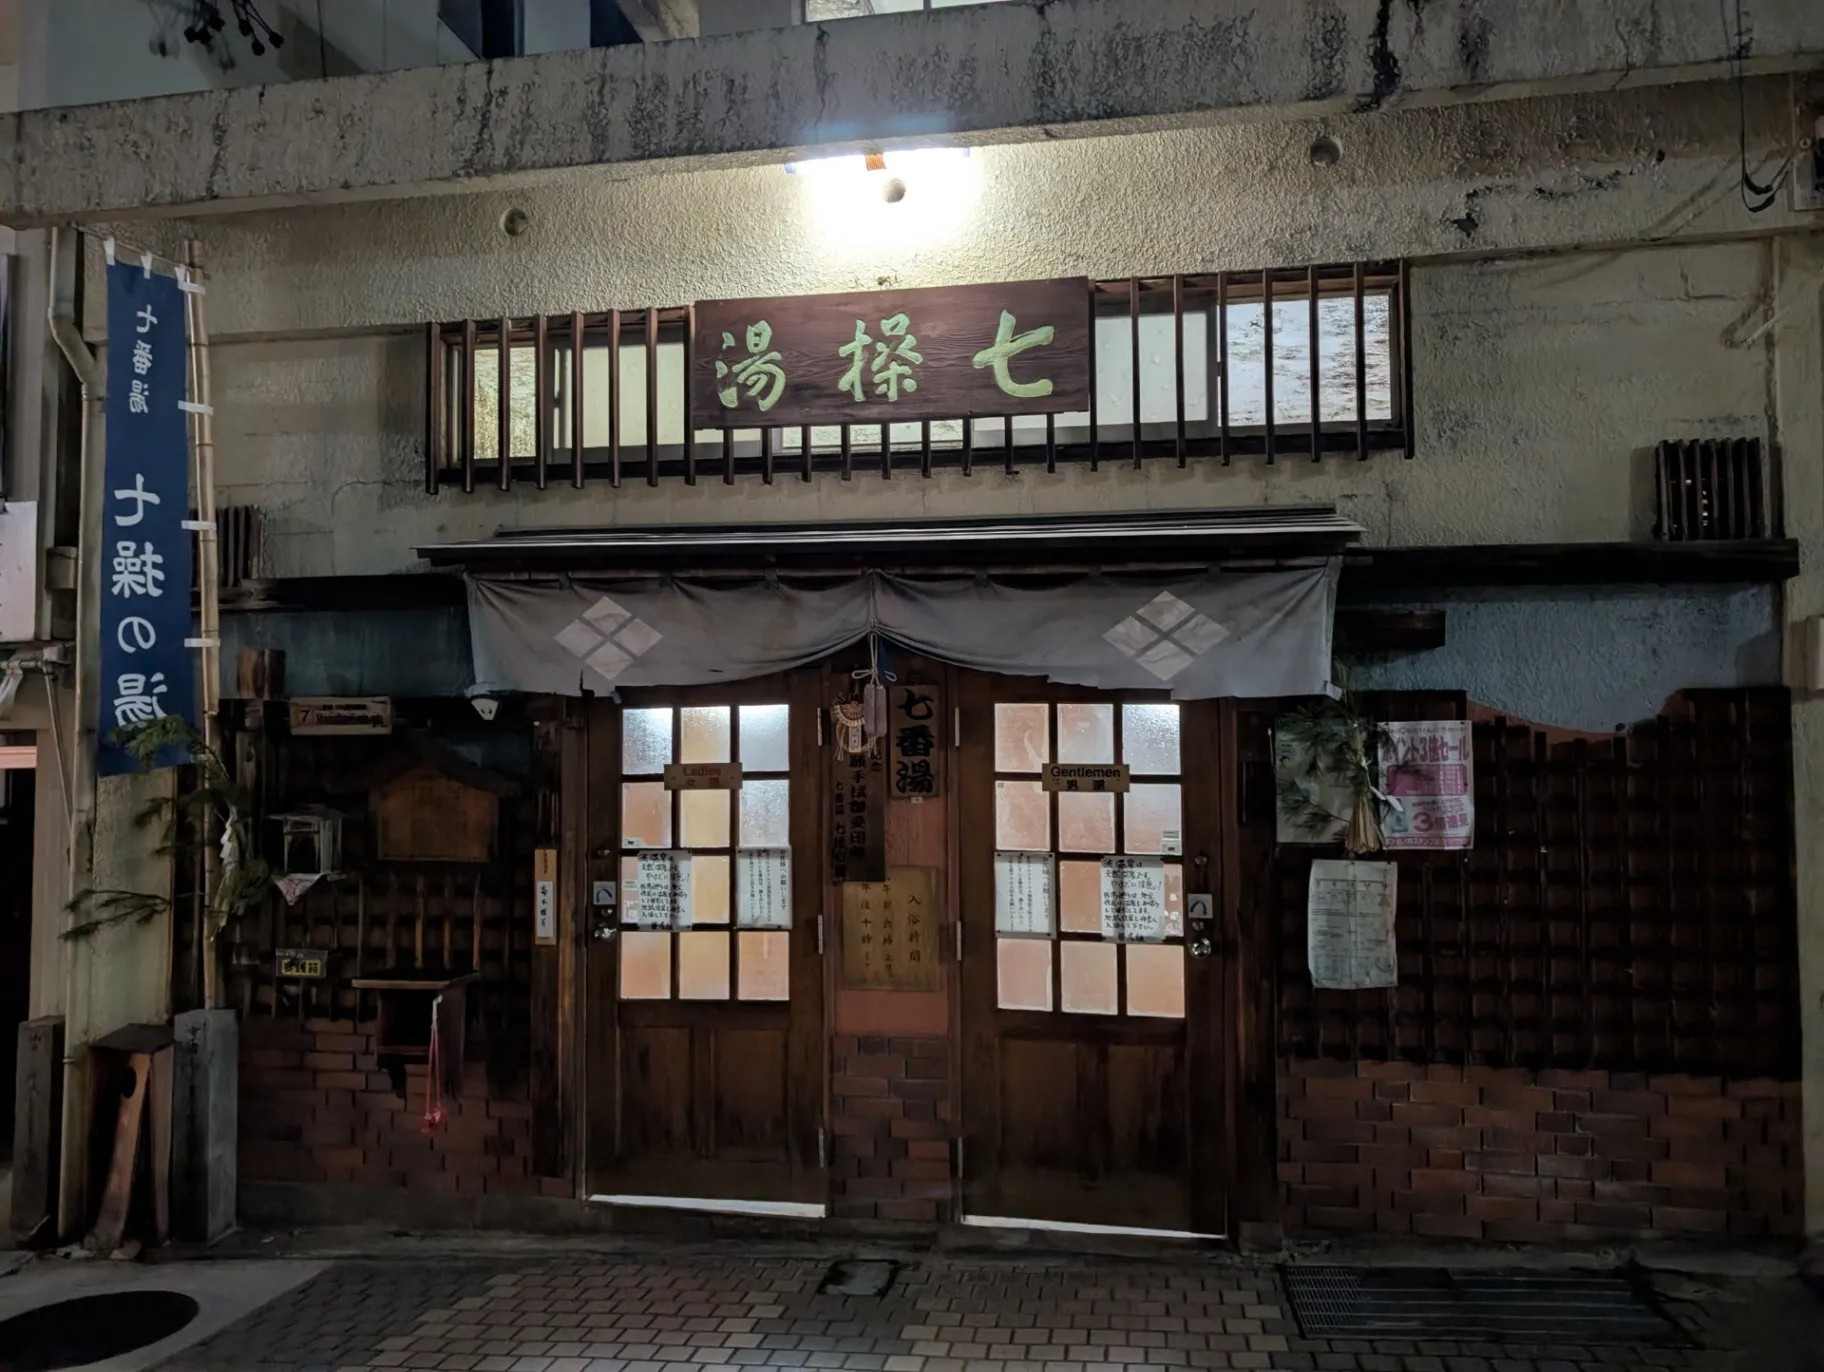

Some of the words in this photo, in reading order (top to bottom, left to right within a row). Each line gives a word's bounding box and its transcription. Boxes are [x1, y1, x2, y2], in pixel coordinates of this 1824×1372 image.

[896, 688, 935, 794] 七番湯
[1051, 766, 1121, 778] Gentlemen
[907, 894, 922, 964] 入浴時間
